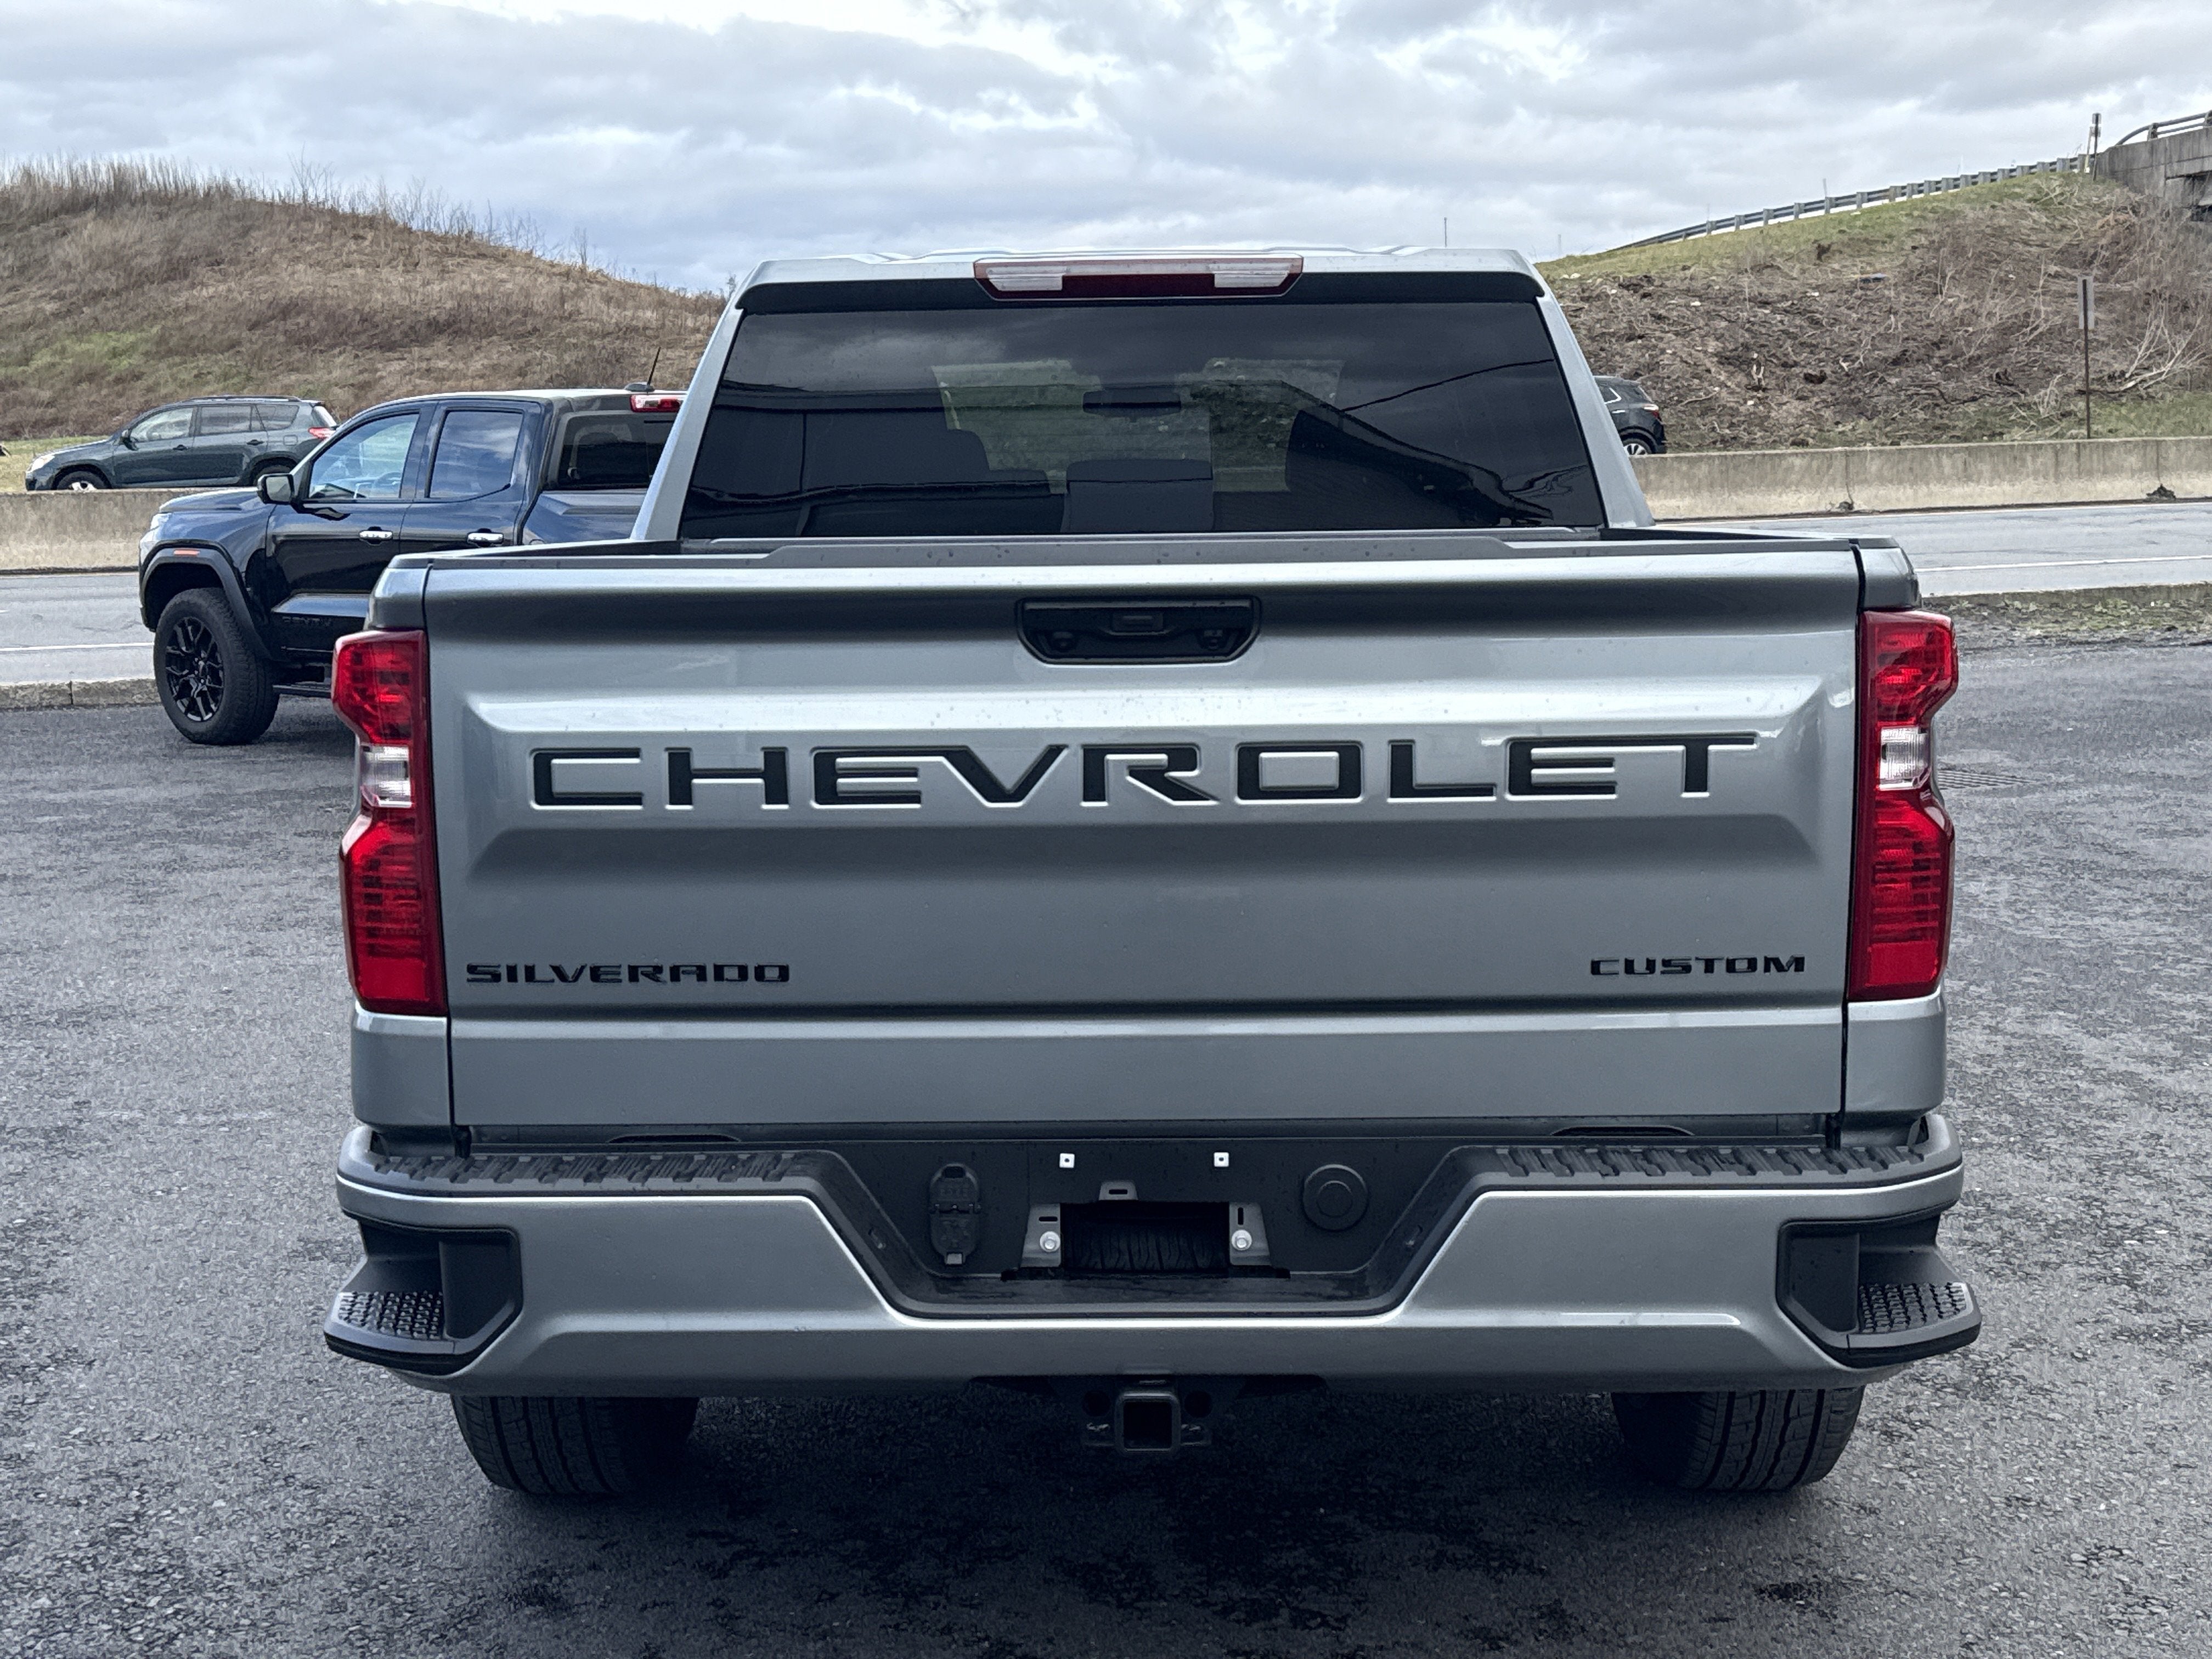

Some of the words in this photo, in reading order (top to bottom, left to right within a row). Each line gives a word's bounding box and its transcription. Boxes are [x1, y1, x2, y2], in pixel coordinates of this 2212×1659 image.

[531, 732, 1757, 809] CHEVROLET
[466, 963, 790, 984] SILVERADO
[1590, 955, 1805, 975] CUSTOM
